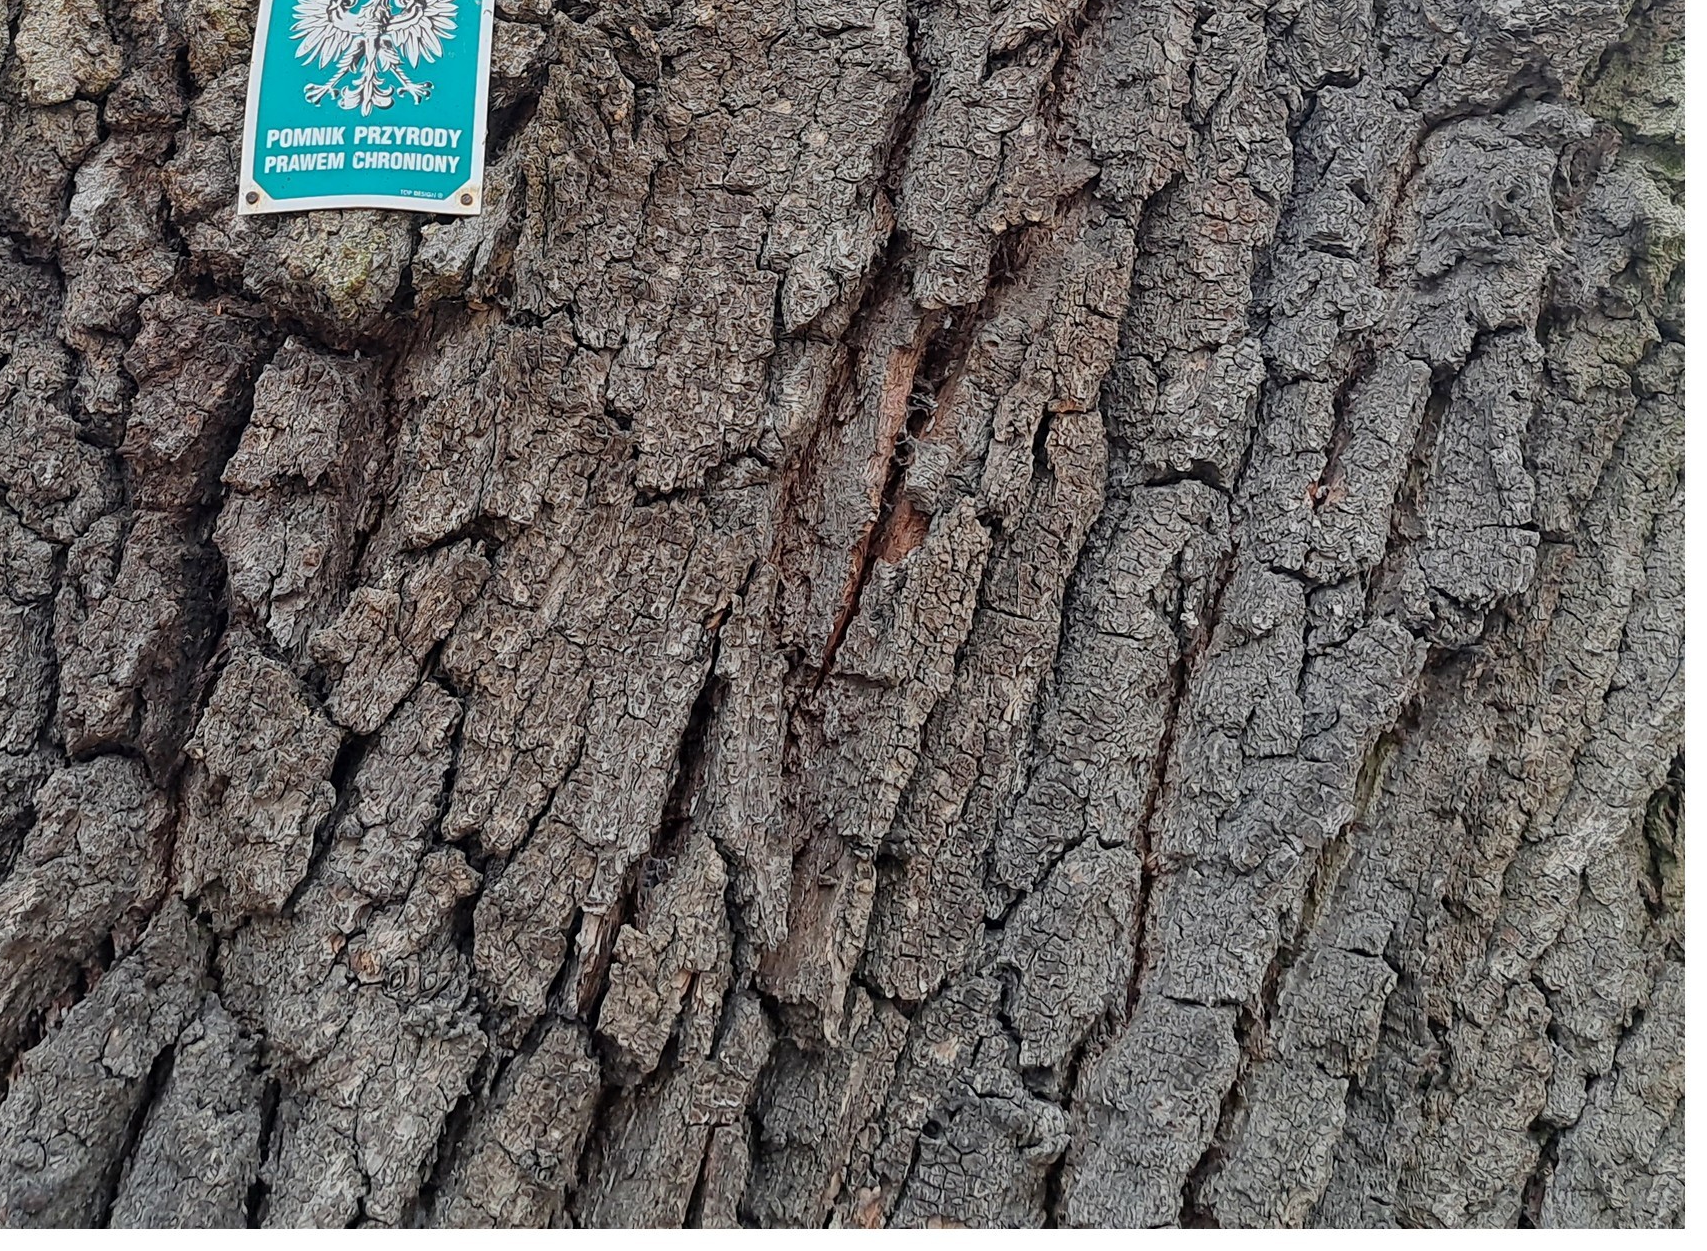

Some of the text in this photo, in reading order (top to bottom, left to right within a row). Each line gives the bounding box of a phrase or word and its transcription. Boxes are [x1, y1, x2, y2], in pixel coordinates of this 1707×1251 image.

[266, 126, 462, 148] POMNIK PRZYRODY
[264, 151, 460, 174] PRAWEM CHRONIONY
